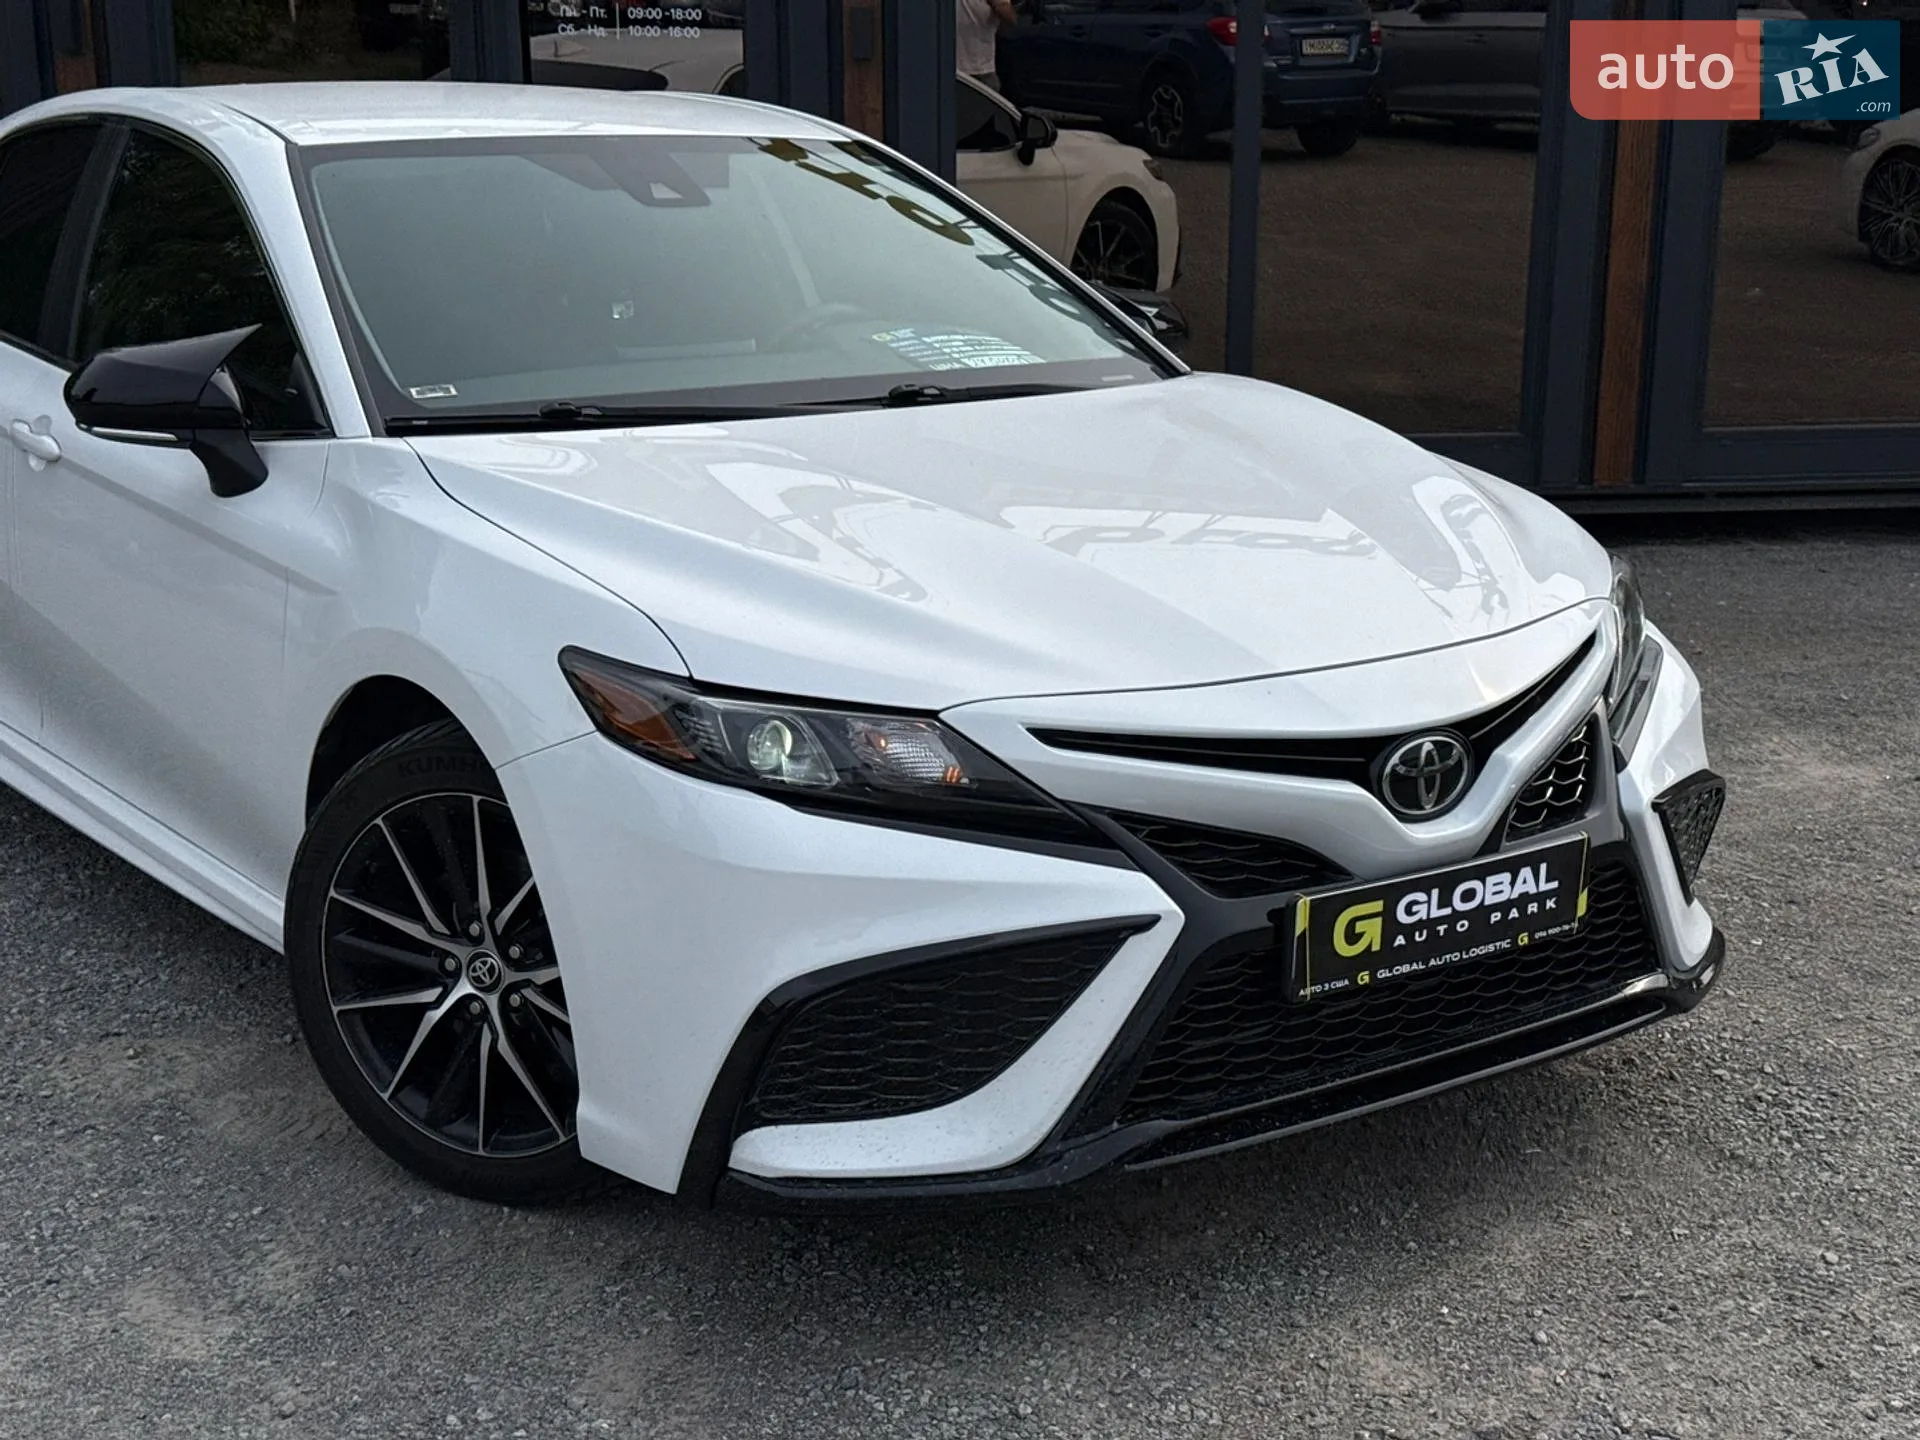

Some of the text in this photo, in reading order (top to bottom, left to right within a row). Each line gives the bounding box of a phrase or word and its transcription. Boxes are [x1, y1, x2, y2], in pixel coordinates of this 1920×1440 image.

[589, 6, 608, 18] Пт.
[627, 7, 663, 20] 09:00
[629, 25, 661, 37] 10:00
[1395, 862, 1559, 925] GLOBAL
[1392, 897, 1558, 948] AUTO PARK
[1376, 960, 1427, 980] GLOBAL
[1427, 950, 1461, 969] AUTO
[1462, 938, 1512, 961] LOGISTIC
